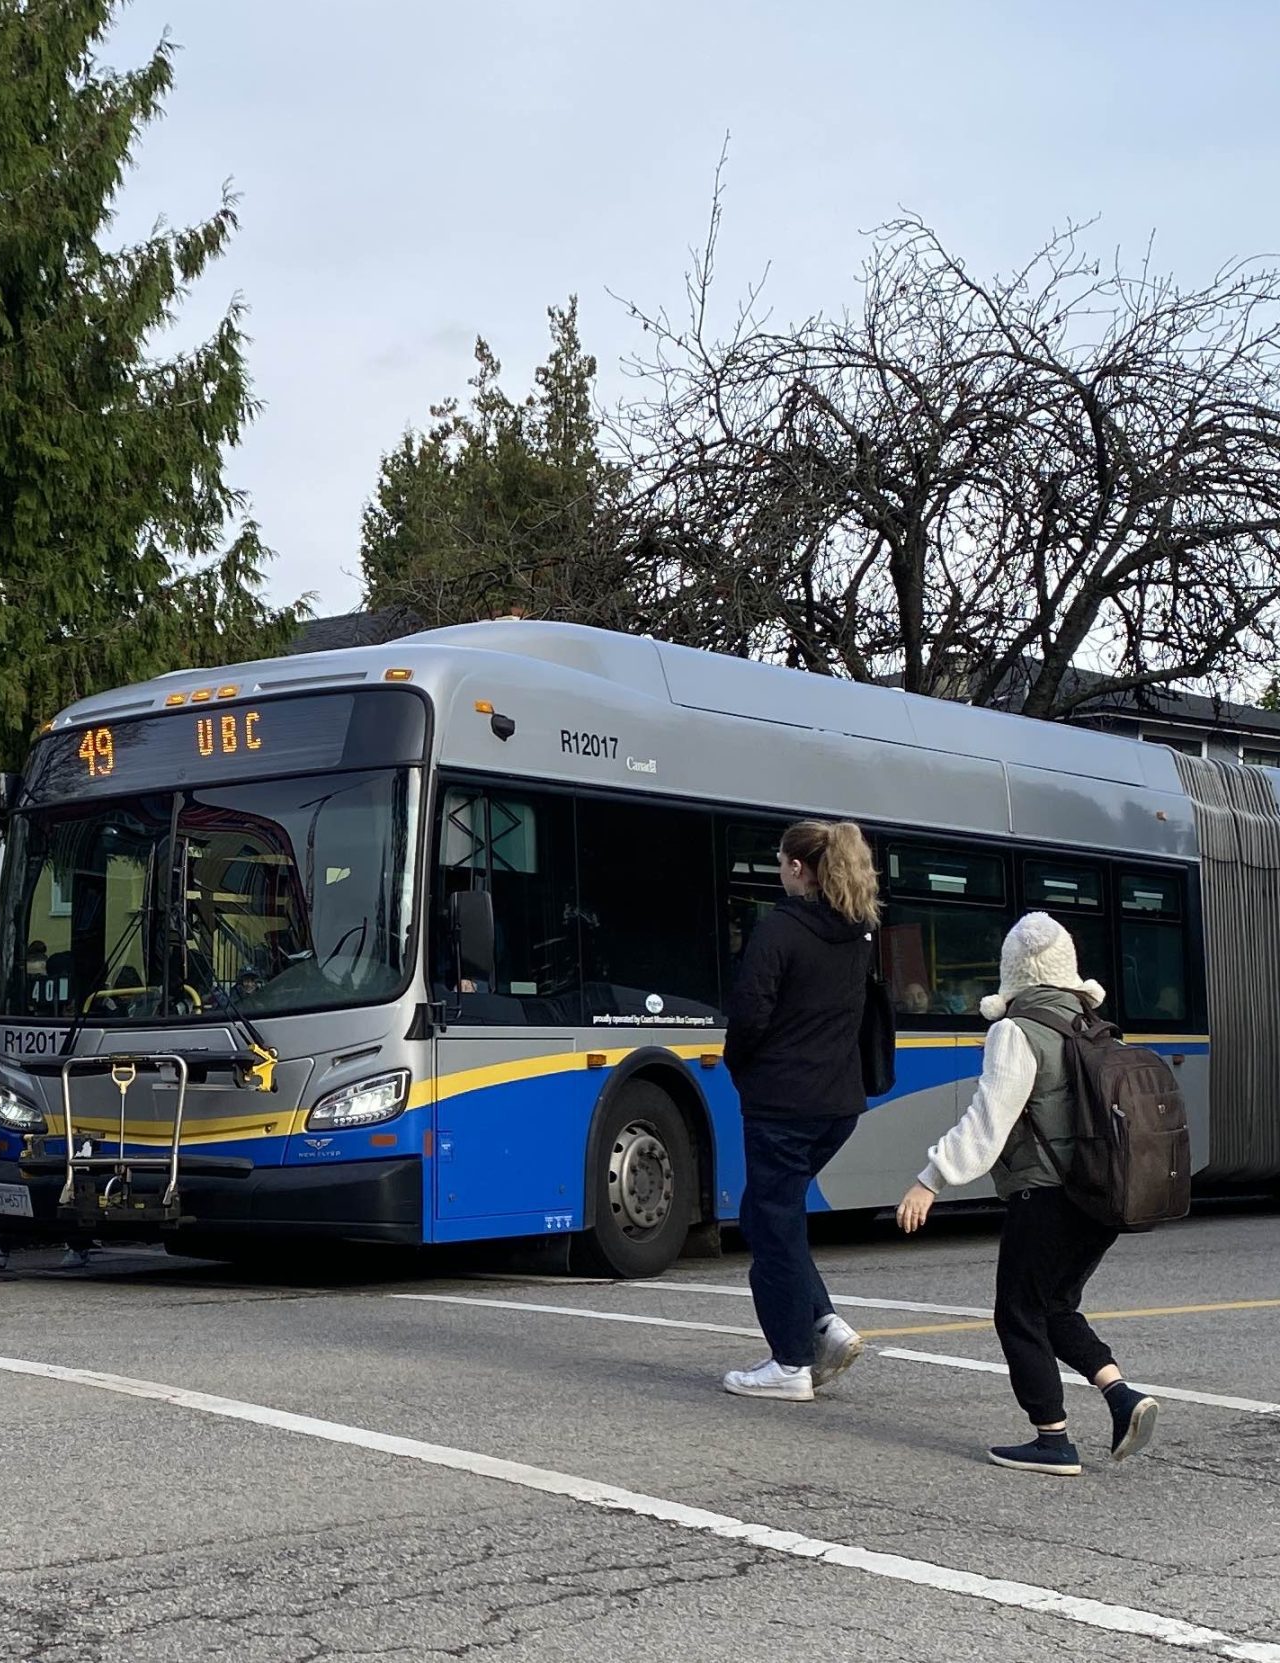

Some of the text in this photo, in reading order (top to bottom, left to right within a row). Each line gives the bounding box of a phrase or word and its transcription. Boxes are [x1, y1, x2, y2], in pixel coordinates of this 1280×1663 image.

[79, 712, 261, 776] 49 UBC
[560, 729, 618, 759] R12017
[626, 756, 657, 774] Canada
[593, 1013, 612, 1025] proudly
[613, 1014, 634, 1025] operated
[640, 1014, 654, 1024] Coast
[654, 1015, 675, 1025] Mountain
[685, 1016, 705, 1026] Company
[4, 1031, 70, 1054] R12017
